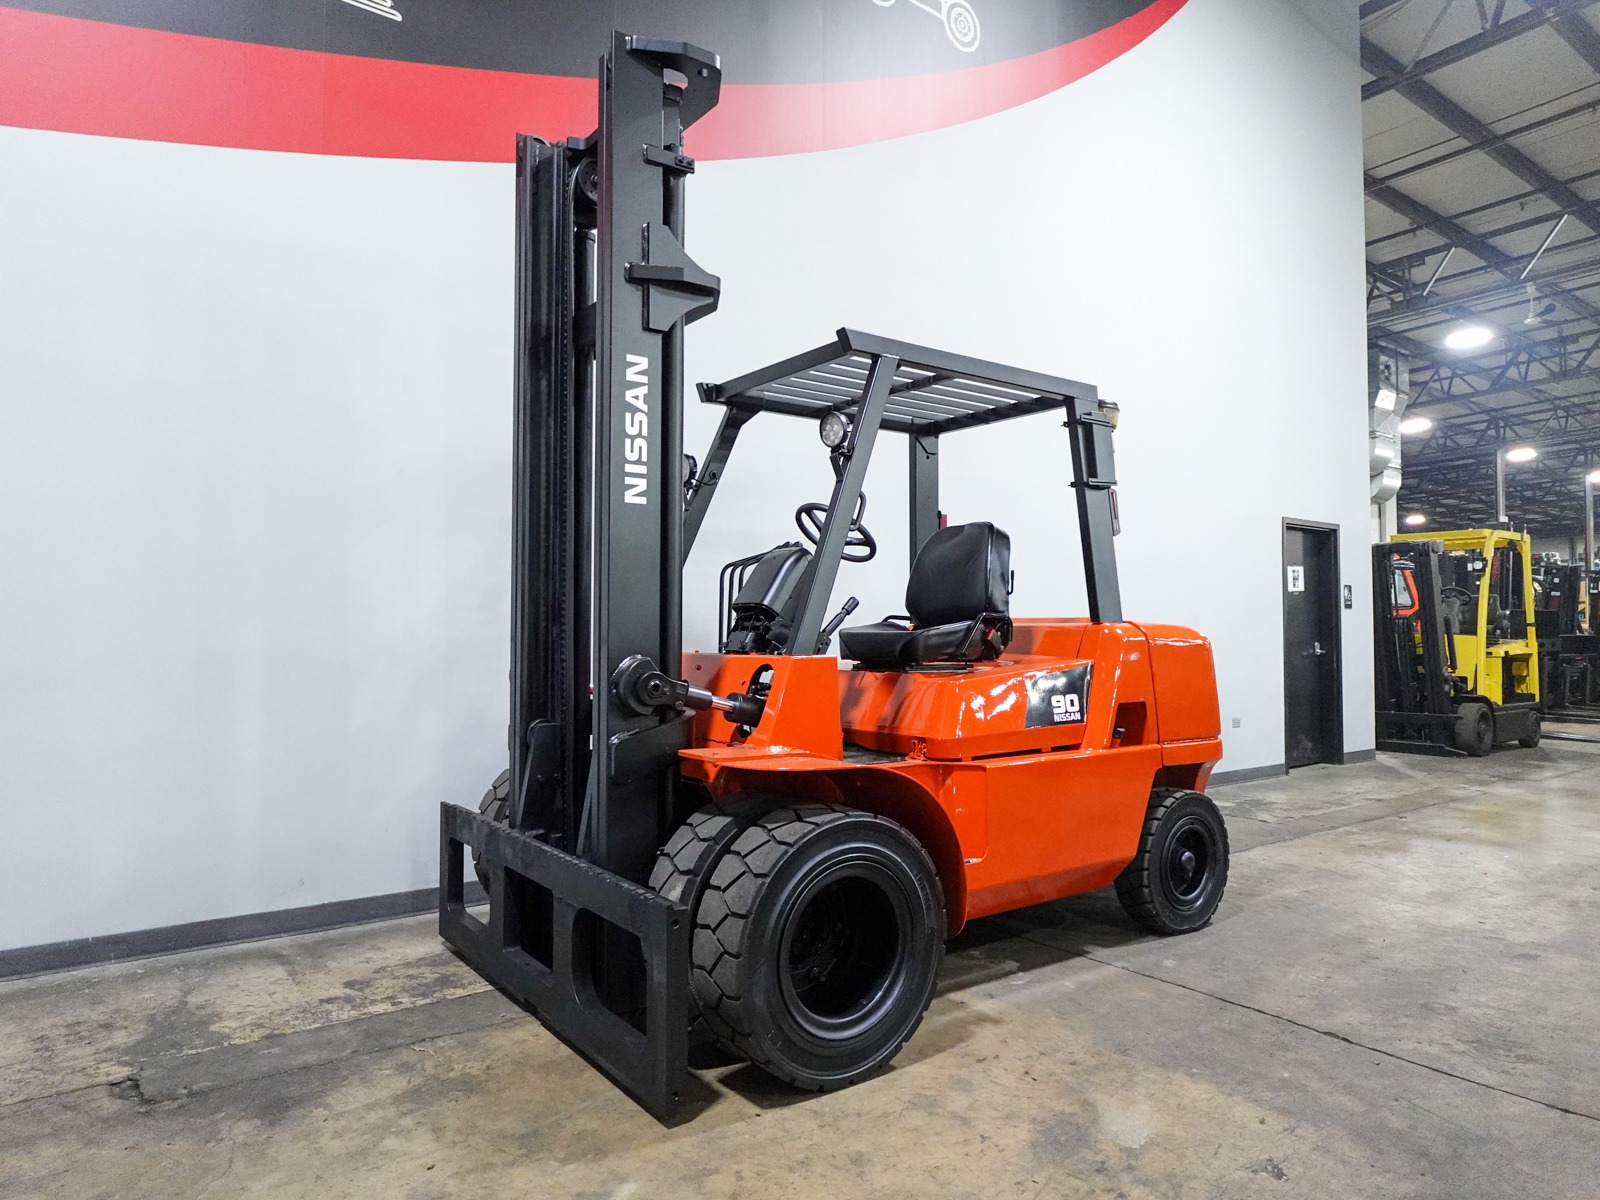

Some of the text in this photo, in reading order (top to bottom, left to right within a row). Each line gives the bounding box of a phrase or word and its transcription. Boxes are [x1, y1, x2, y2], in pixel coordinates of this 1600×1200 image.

[624, 353, 649, 504] NISSAN
[1051, 694, 1080, 714] 90
[1054, 712, 1081, 722] NISSAN
